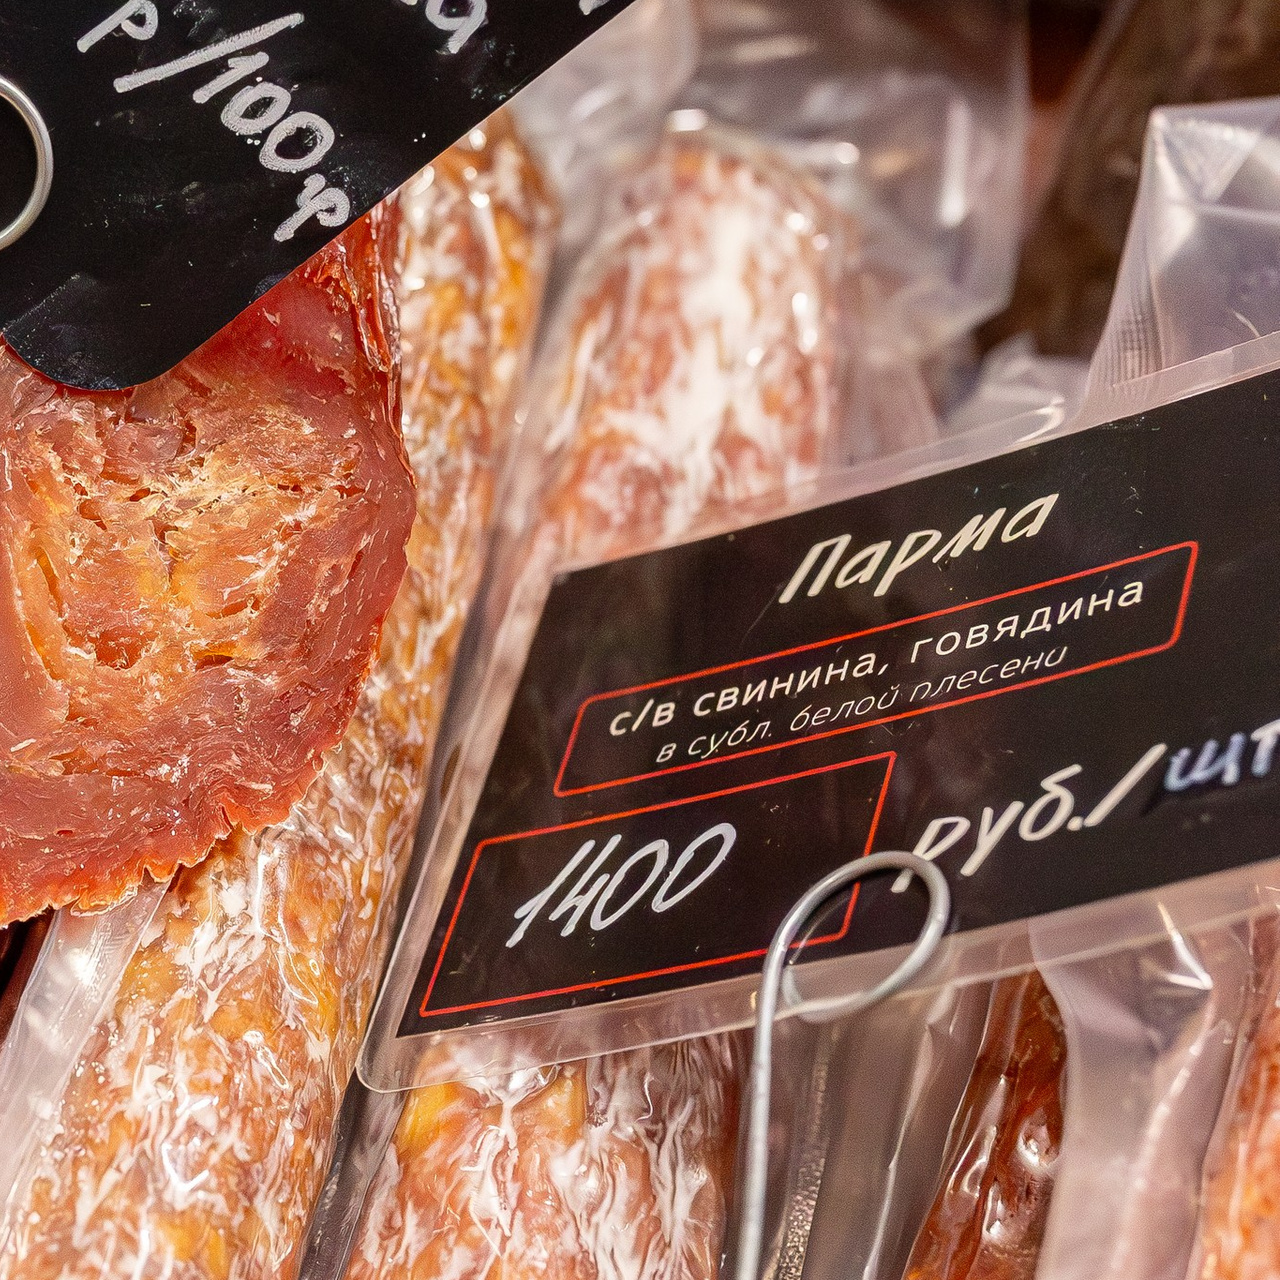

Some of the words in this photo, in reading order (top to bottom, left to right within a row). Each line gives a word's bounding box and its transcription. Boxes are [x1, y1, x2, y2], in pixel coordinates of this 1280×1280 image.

[778, 492, 1061, 604] Парма
[608, 697, 675, 737] с/в
[692, 650, 889, 718] свинина,
[909, 580, 1144, 664] говядина
[655, 741, 677, 763] в
[687, 720, 773, 760] субл.
[789, 683, 900, 733] белой
[908, 645, 1069, 702] плесени
[505, 821, 738, 950] 1400
